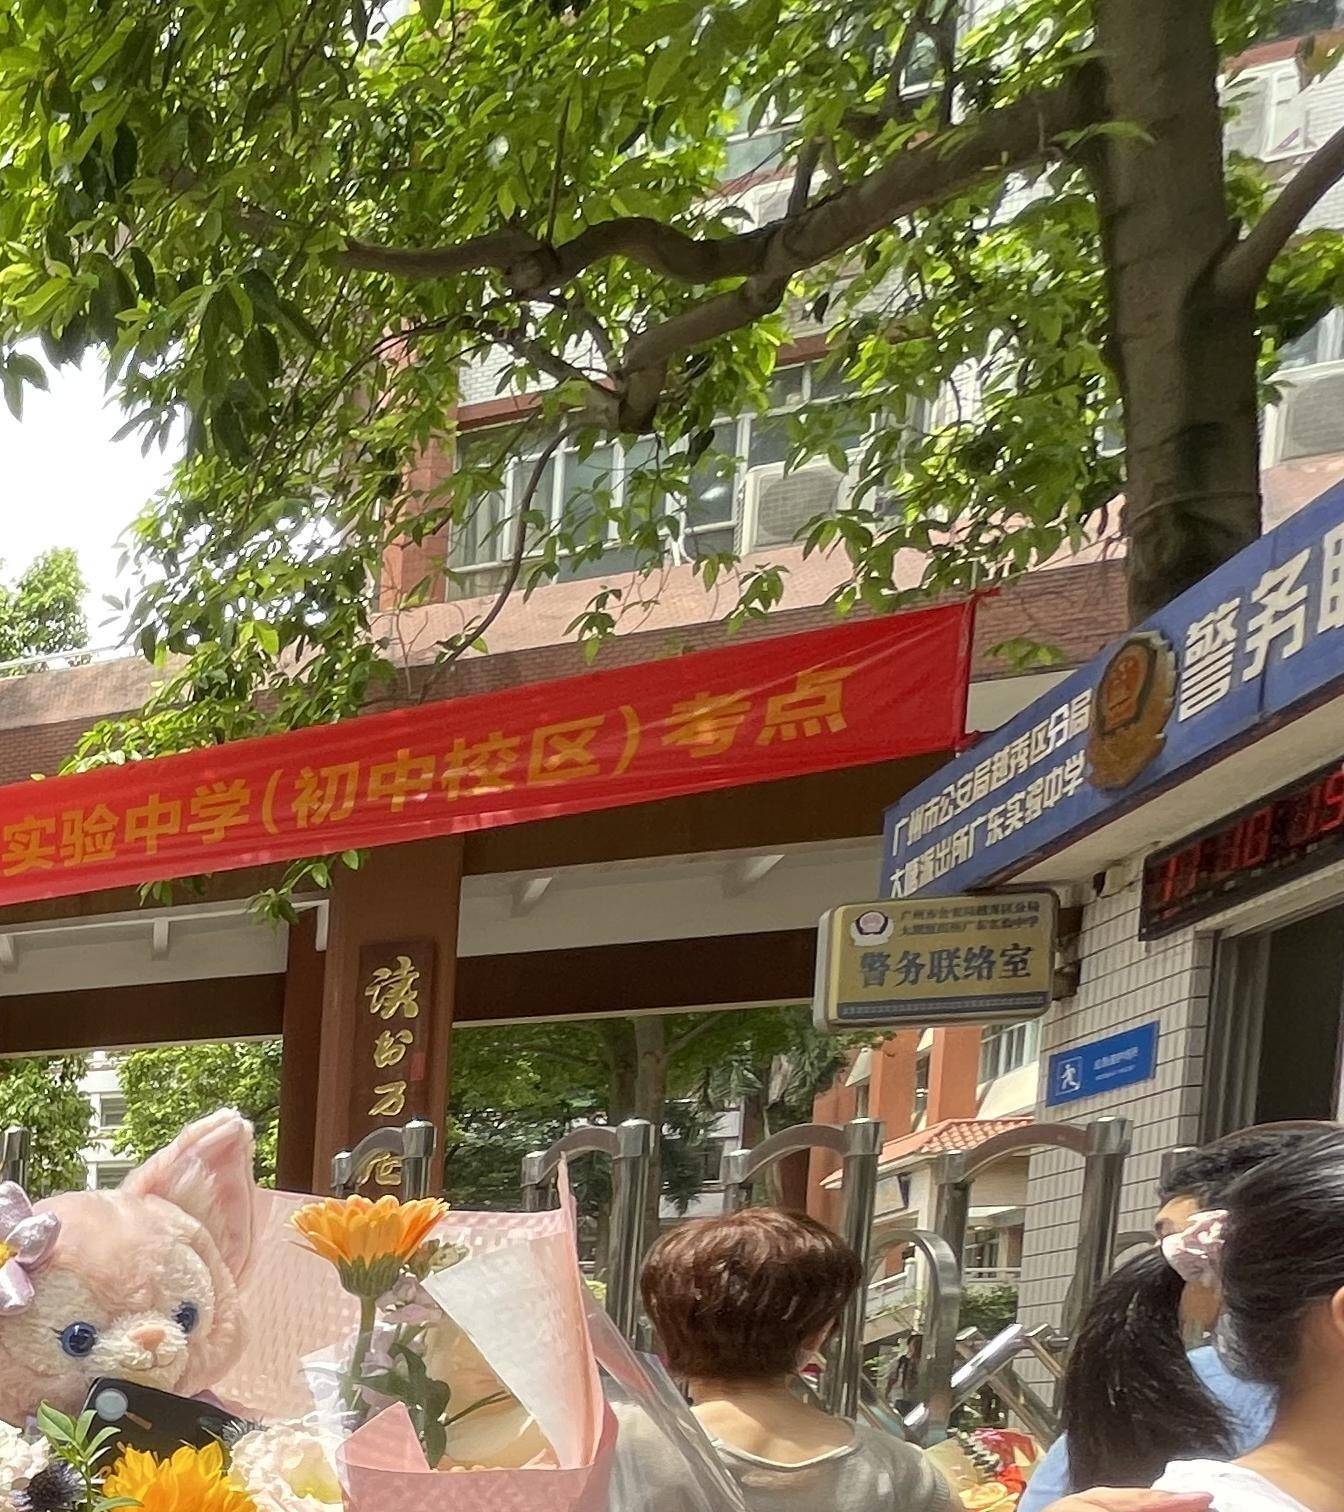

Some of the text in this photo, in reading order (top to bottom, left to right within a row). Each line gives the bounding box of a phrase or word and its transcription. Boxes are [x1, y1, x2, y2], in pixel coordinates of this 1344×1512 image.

[861, 942, 1033, 988] 警务联络室
